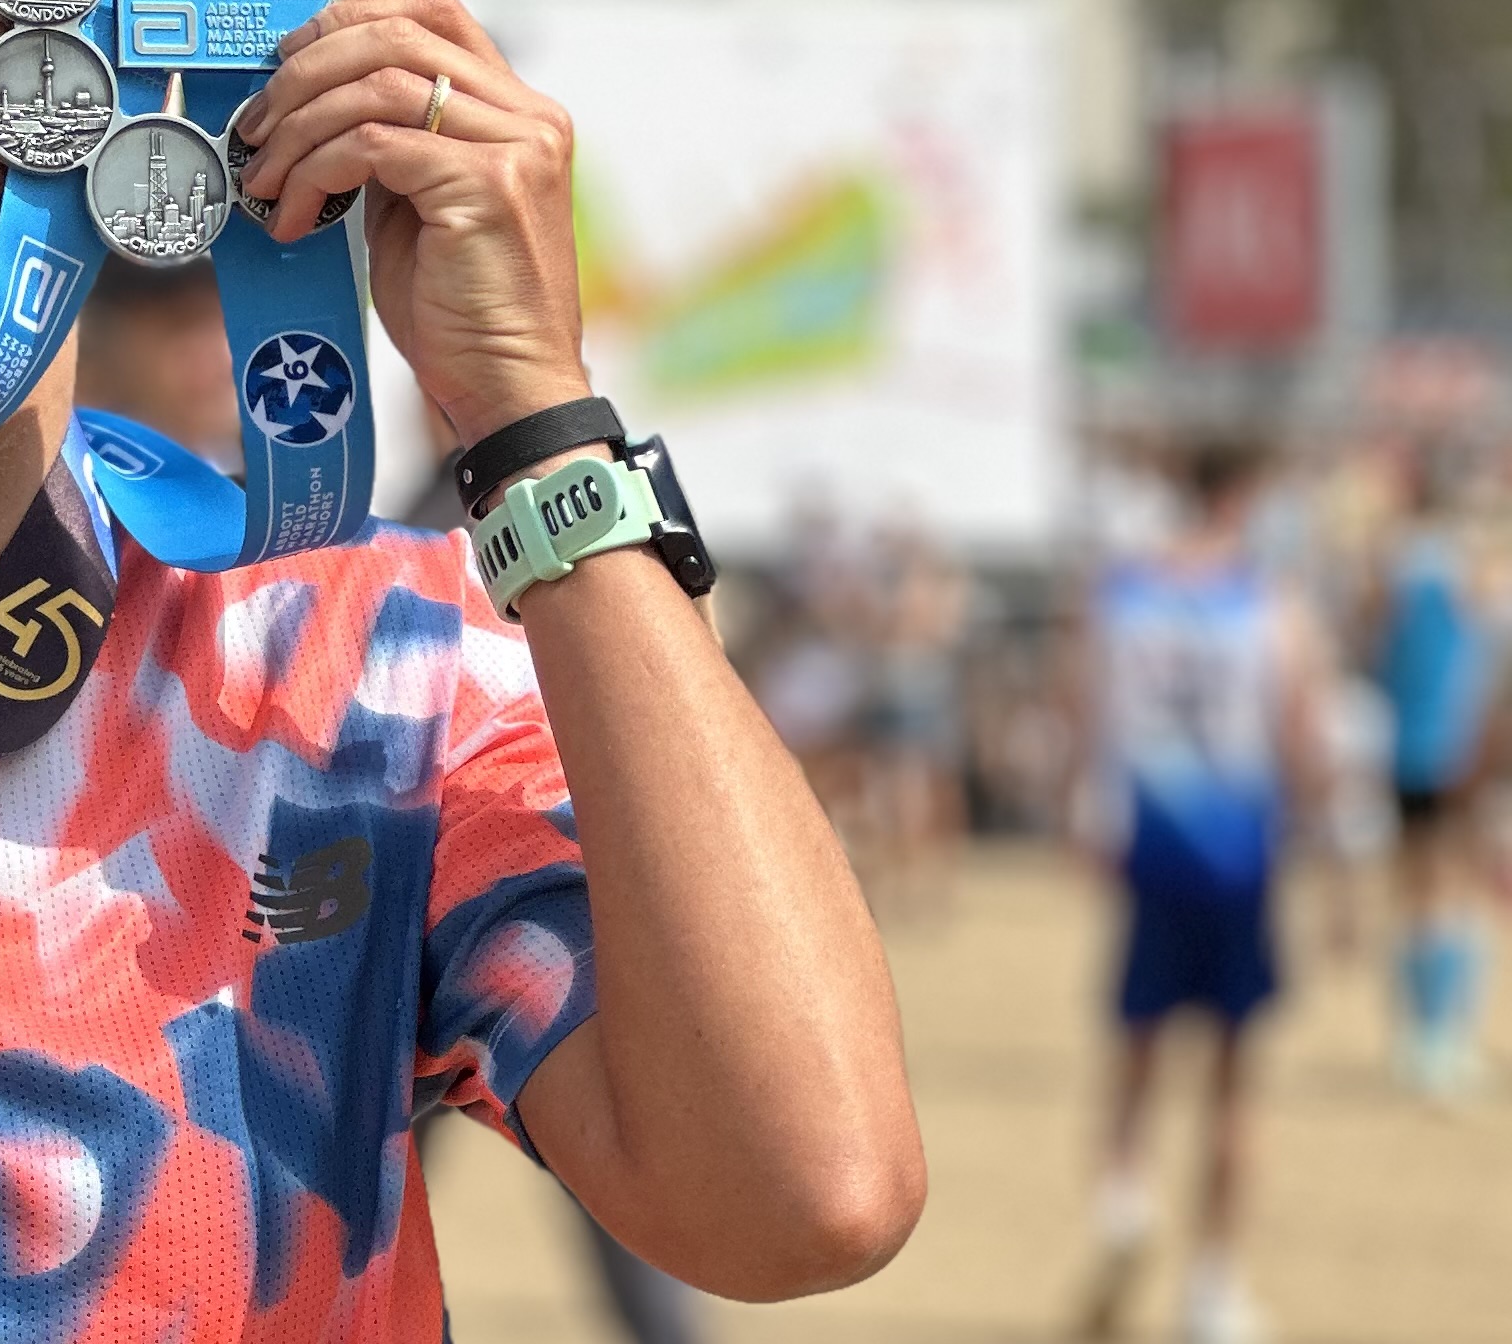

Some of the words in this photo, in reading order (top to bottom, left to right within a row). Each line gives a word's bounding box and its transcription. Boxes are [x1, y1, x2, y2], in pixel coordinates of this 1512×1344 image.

[12, 0, 80, 21] LONDON
[206, 2, 271, 16] ABBOTT
[206, 15, 266, 30] WORLD
[207, 42, 276, 56] MAJORS
[25, 149, 75, 166] BERLIN
[129, 236, 198, 256] CHICAGO
